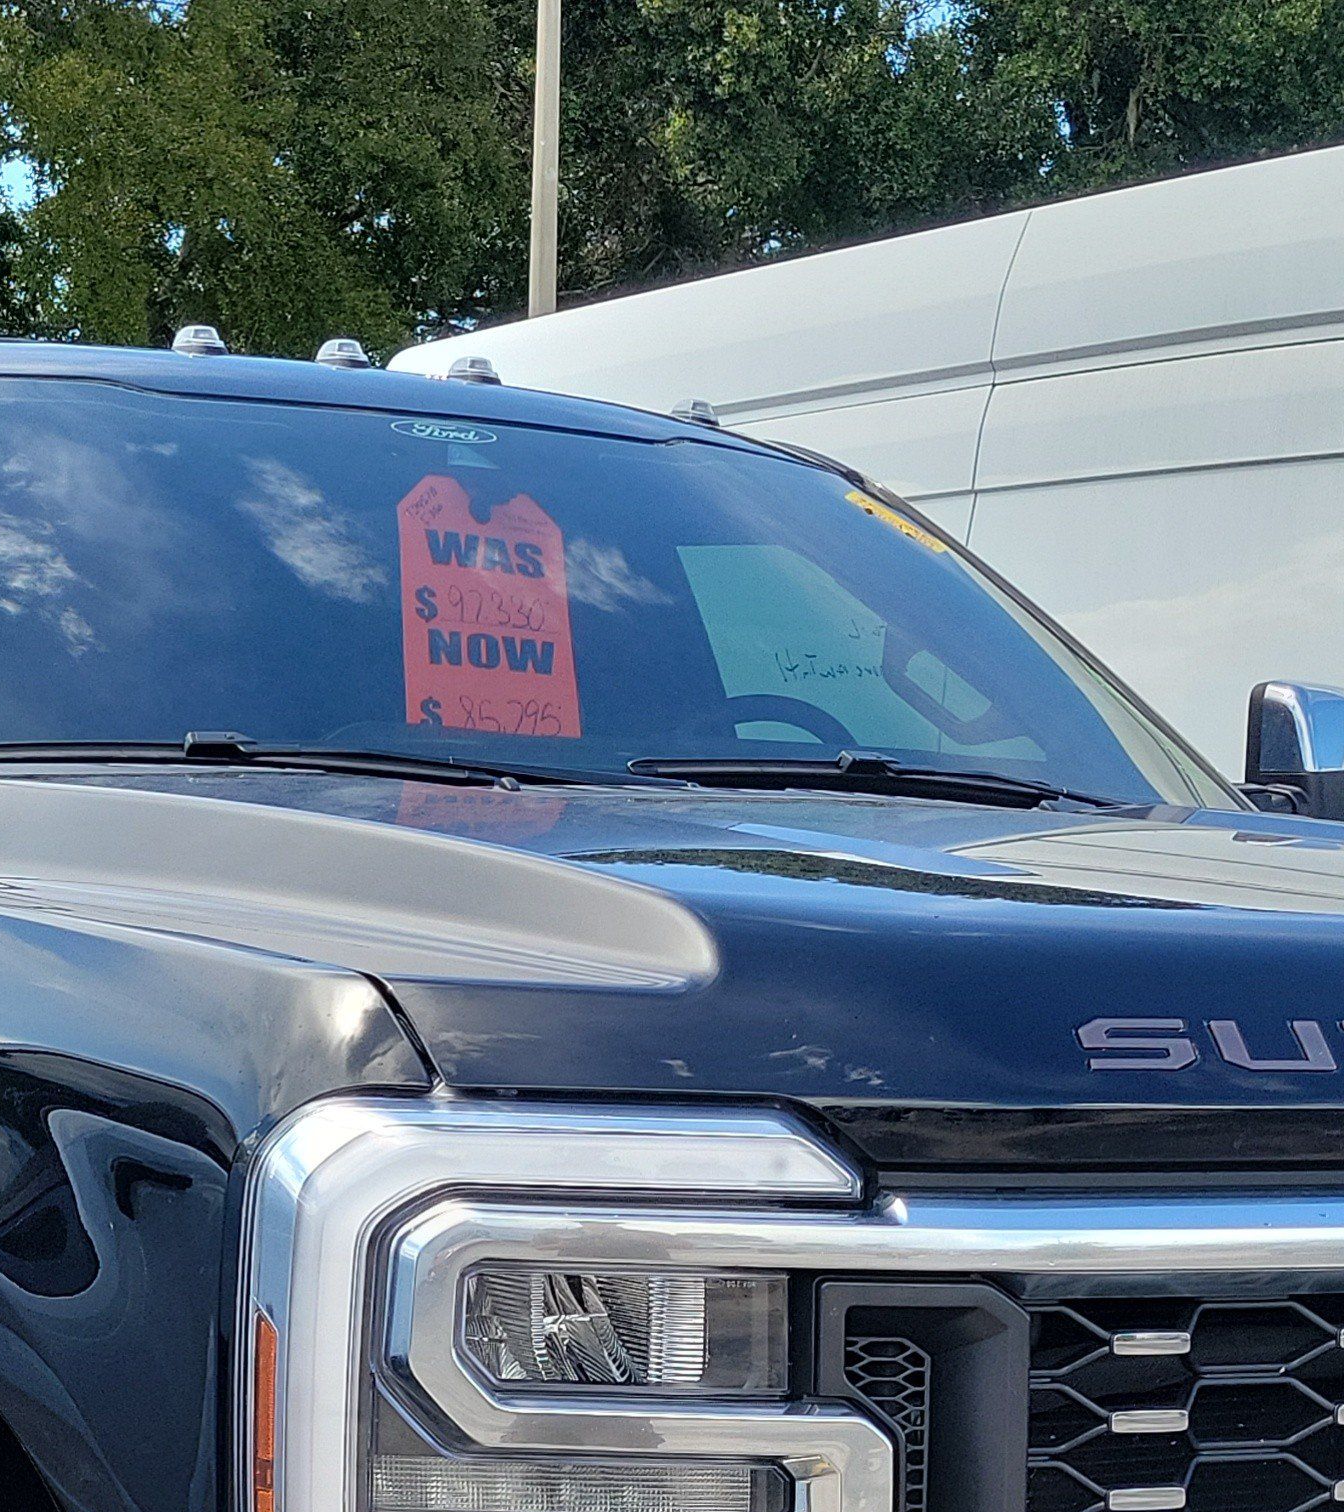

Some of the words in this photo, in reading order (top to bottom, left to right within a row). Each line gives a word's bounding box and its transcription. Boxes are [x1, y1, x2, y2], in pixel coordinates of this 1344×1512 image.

[412, 422, 480, 441] Ford
[424, 528, 547, 579] WAS
[427, 629, 556, 676] NOW
